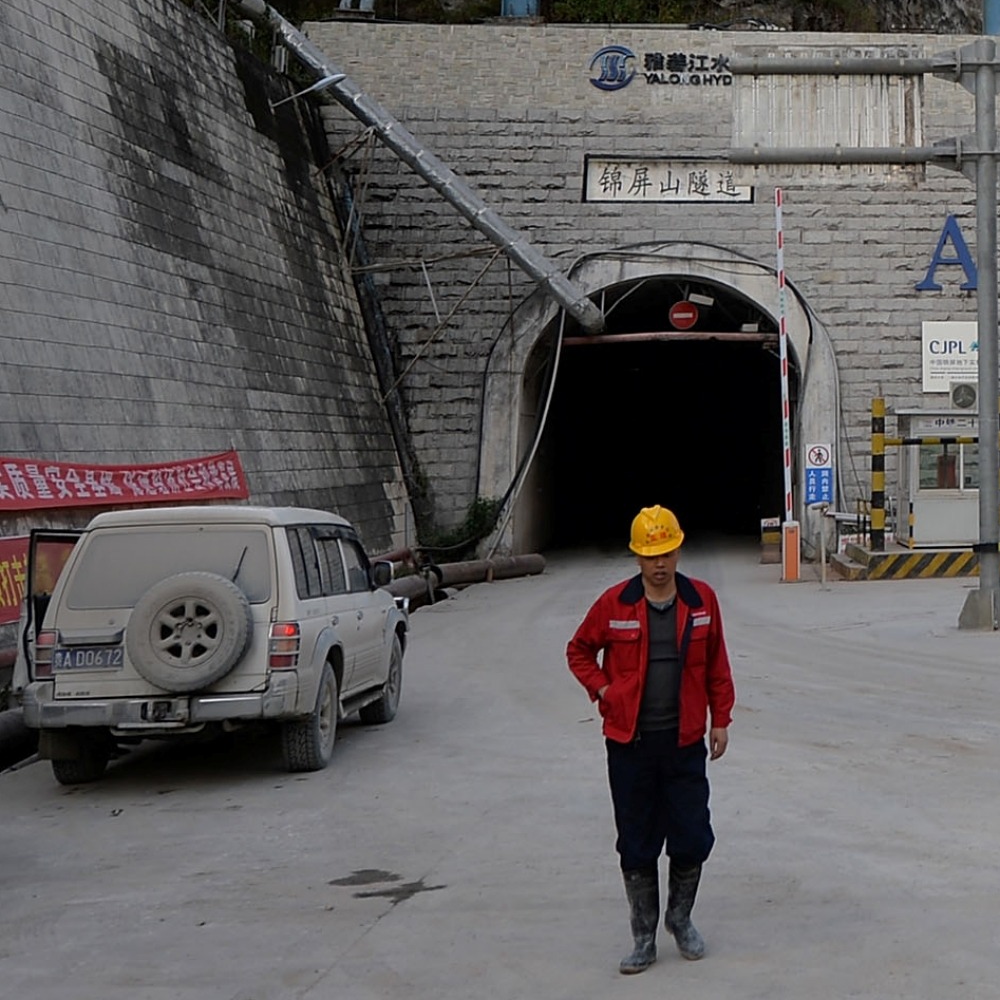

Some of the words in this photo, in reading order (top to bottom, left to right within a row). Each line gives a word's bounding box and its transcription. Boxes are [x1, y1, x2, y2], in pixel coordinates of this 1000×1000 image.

[598, 167, 741, 197] 锦屏山隧道
[914, 213, 978, 291] A
[929, 340, 967, 354] CJPL
